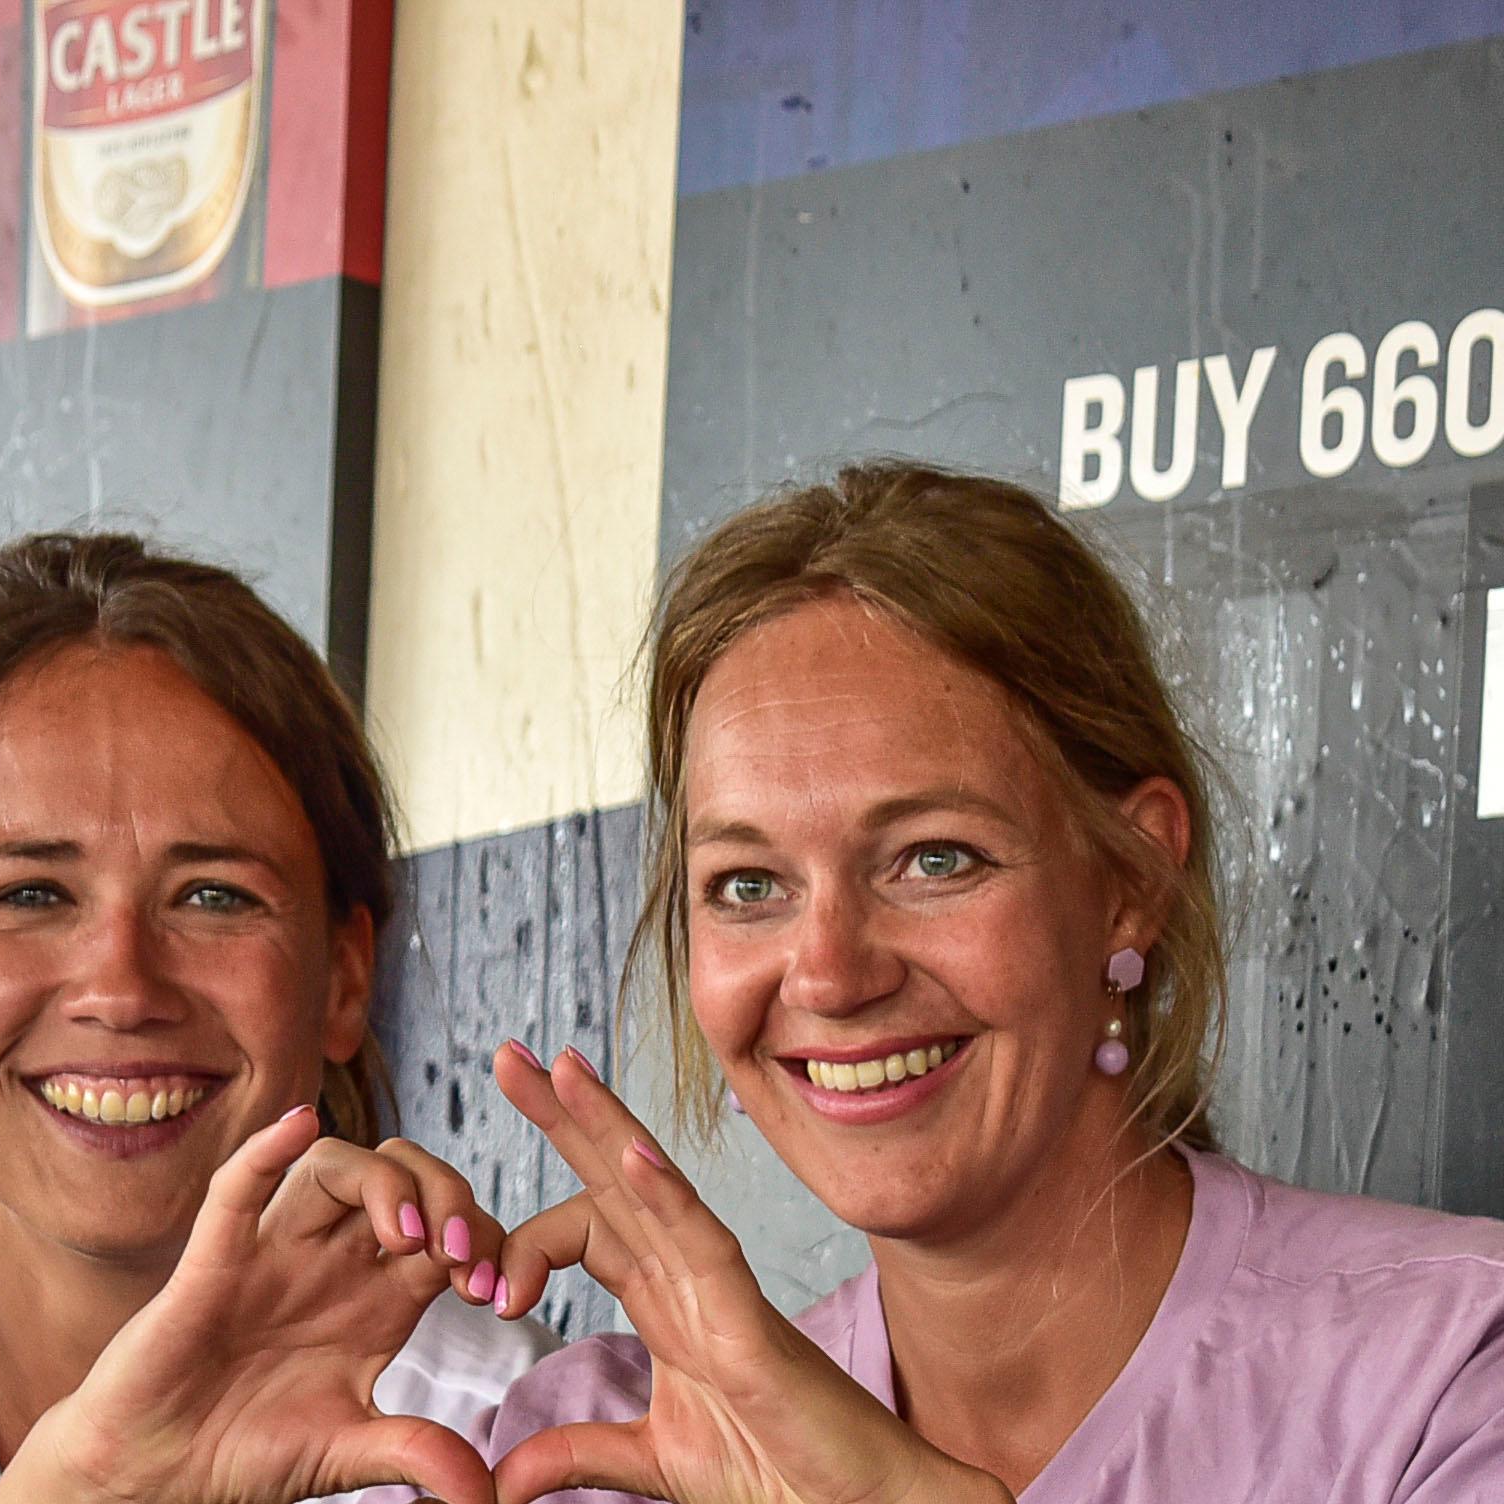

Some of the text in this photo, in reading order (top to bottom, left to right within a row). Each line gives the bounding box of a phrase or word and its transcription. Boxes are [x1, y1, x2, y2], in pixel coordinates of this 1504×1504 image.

[50, 0, 246, 93] CASTLE
[105, 71, 186, 117] LAGER
[1059, 345, 1277, 512] BUY
